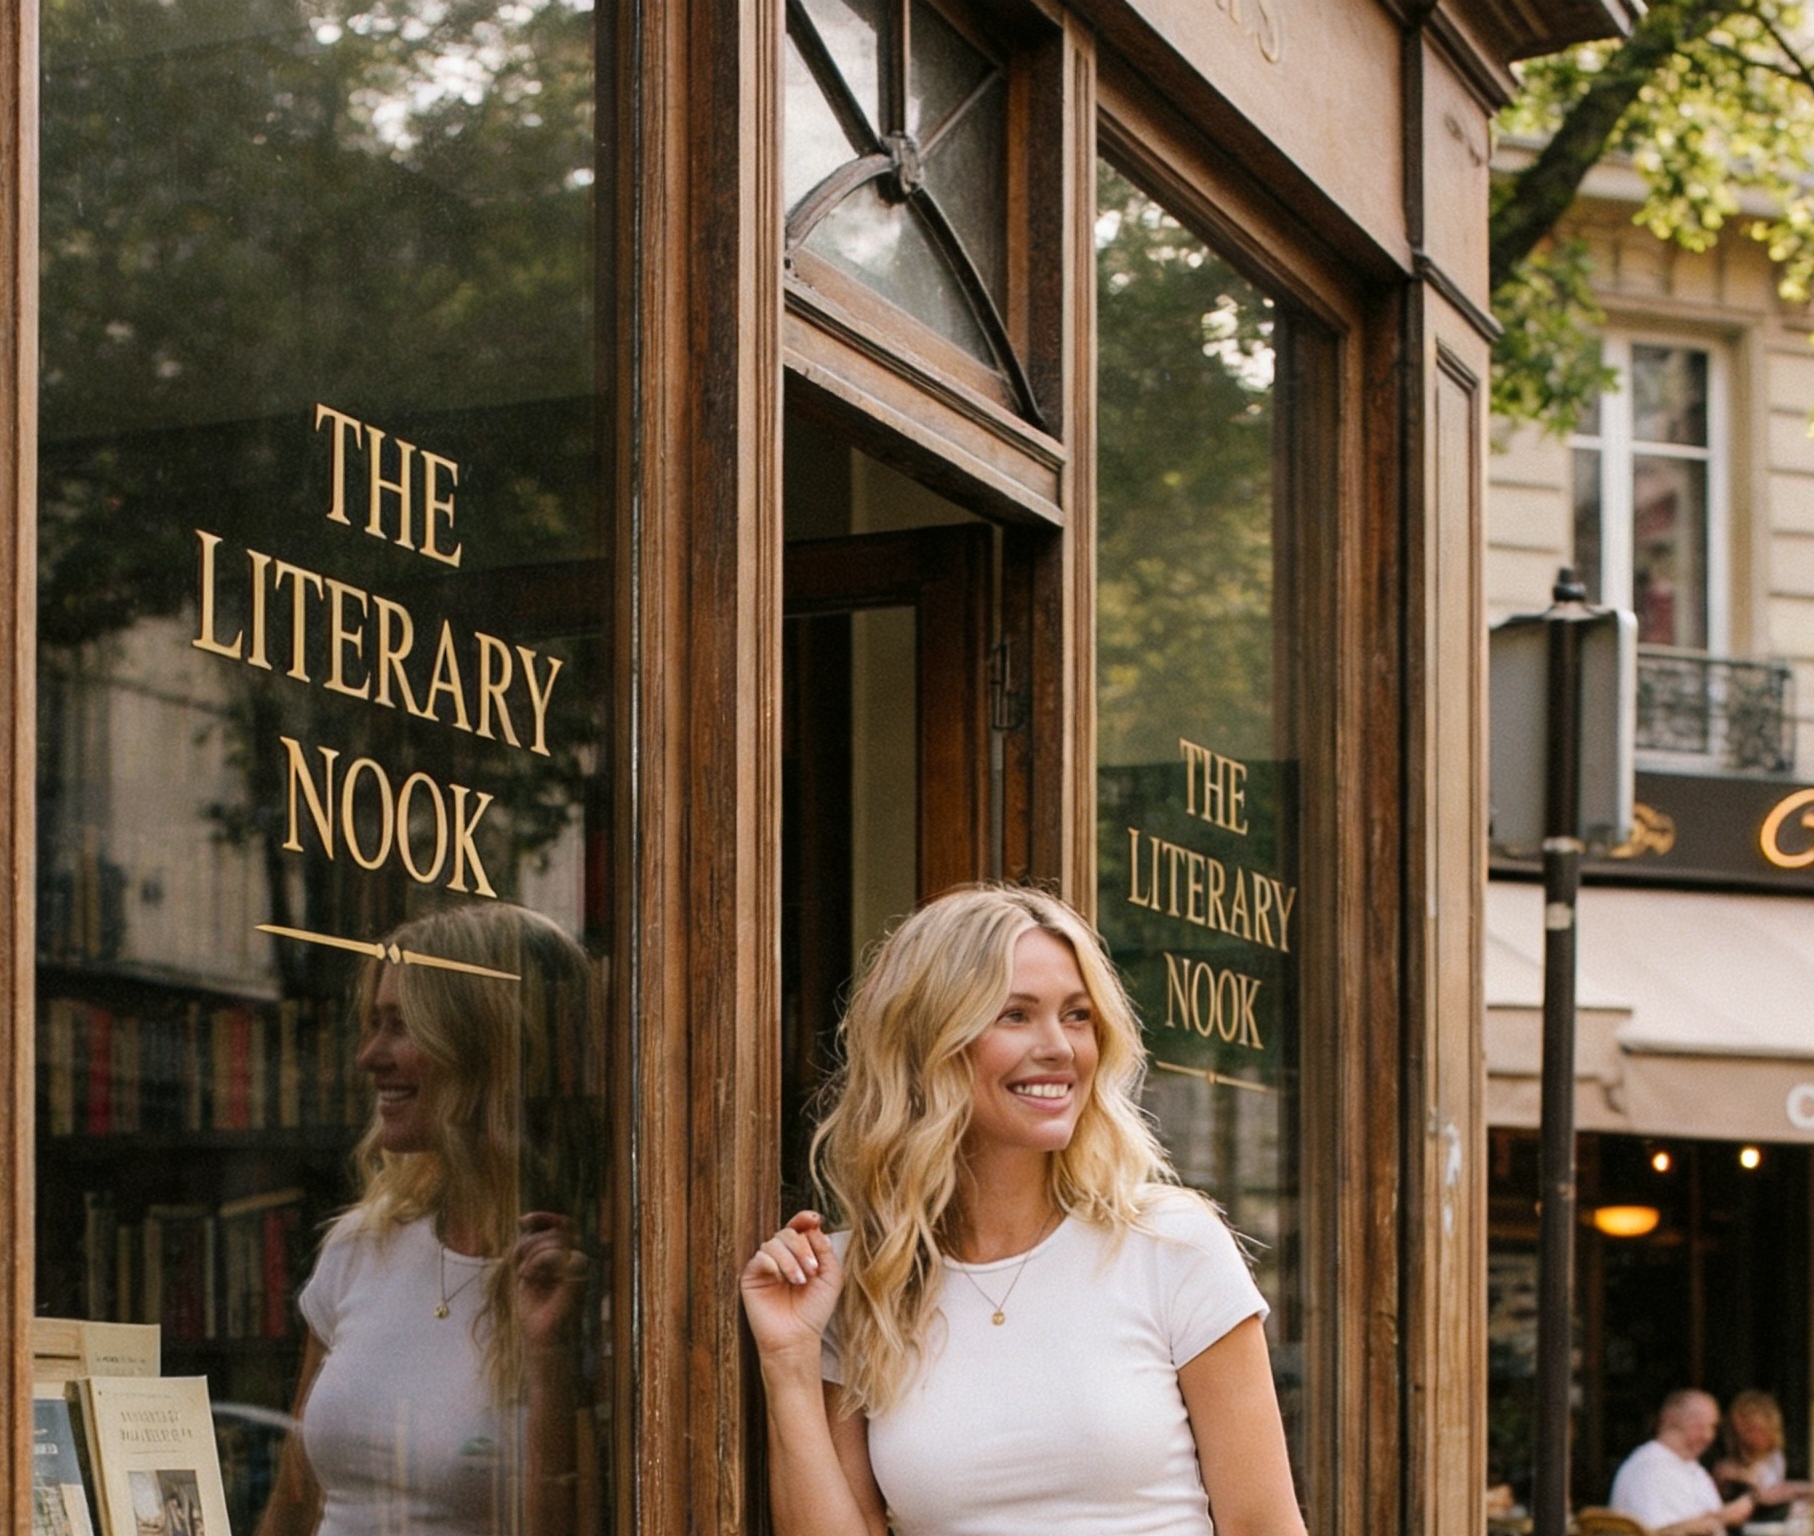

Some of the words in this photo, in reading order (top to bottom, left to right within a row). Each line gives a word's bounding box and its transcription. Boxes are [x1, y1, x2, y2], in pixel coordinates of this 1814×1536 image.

[315, 402, 462, 568] THE
[191, 528, 564, 757] LITERARY
[279, 735, 498, 899] NOOK
[1179, 737, 1248, 836] THE
[1127, 826, 1297, 954] LITERARY
[1163, 951, 1265, 1051] NOOK
